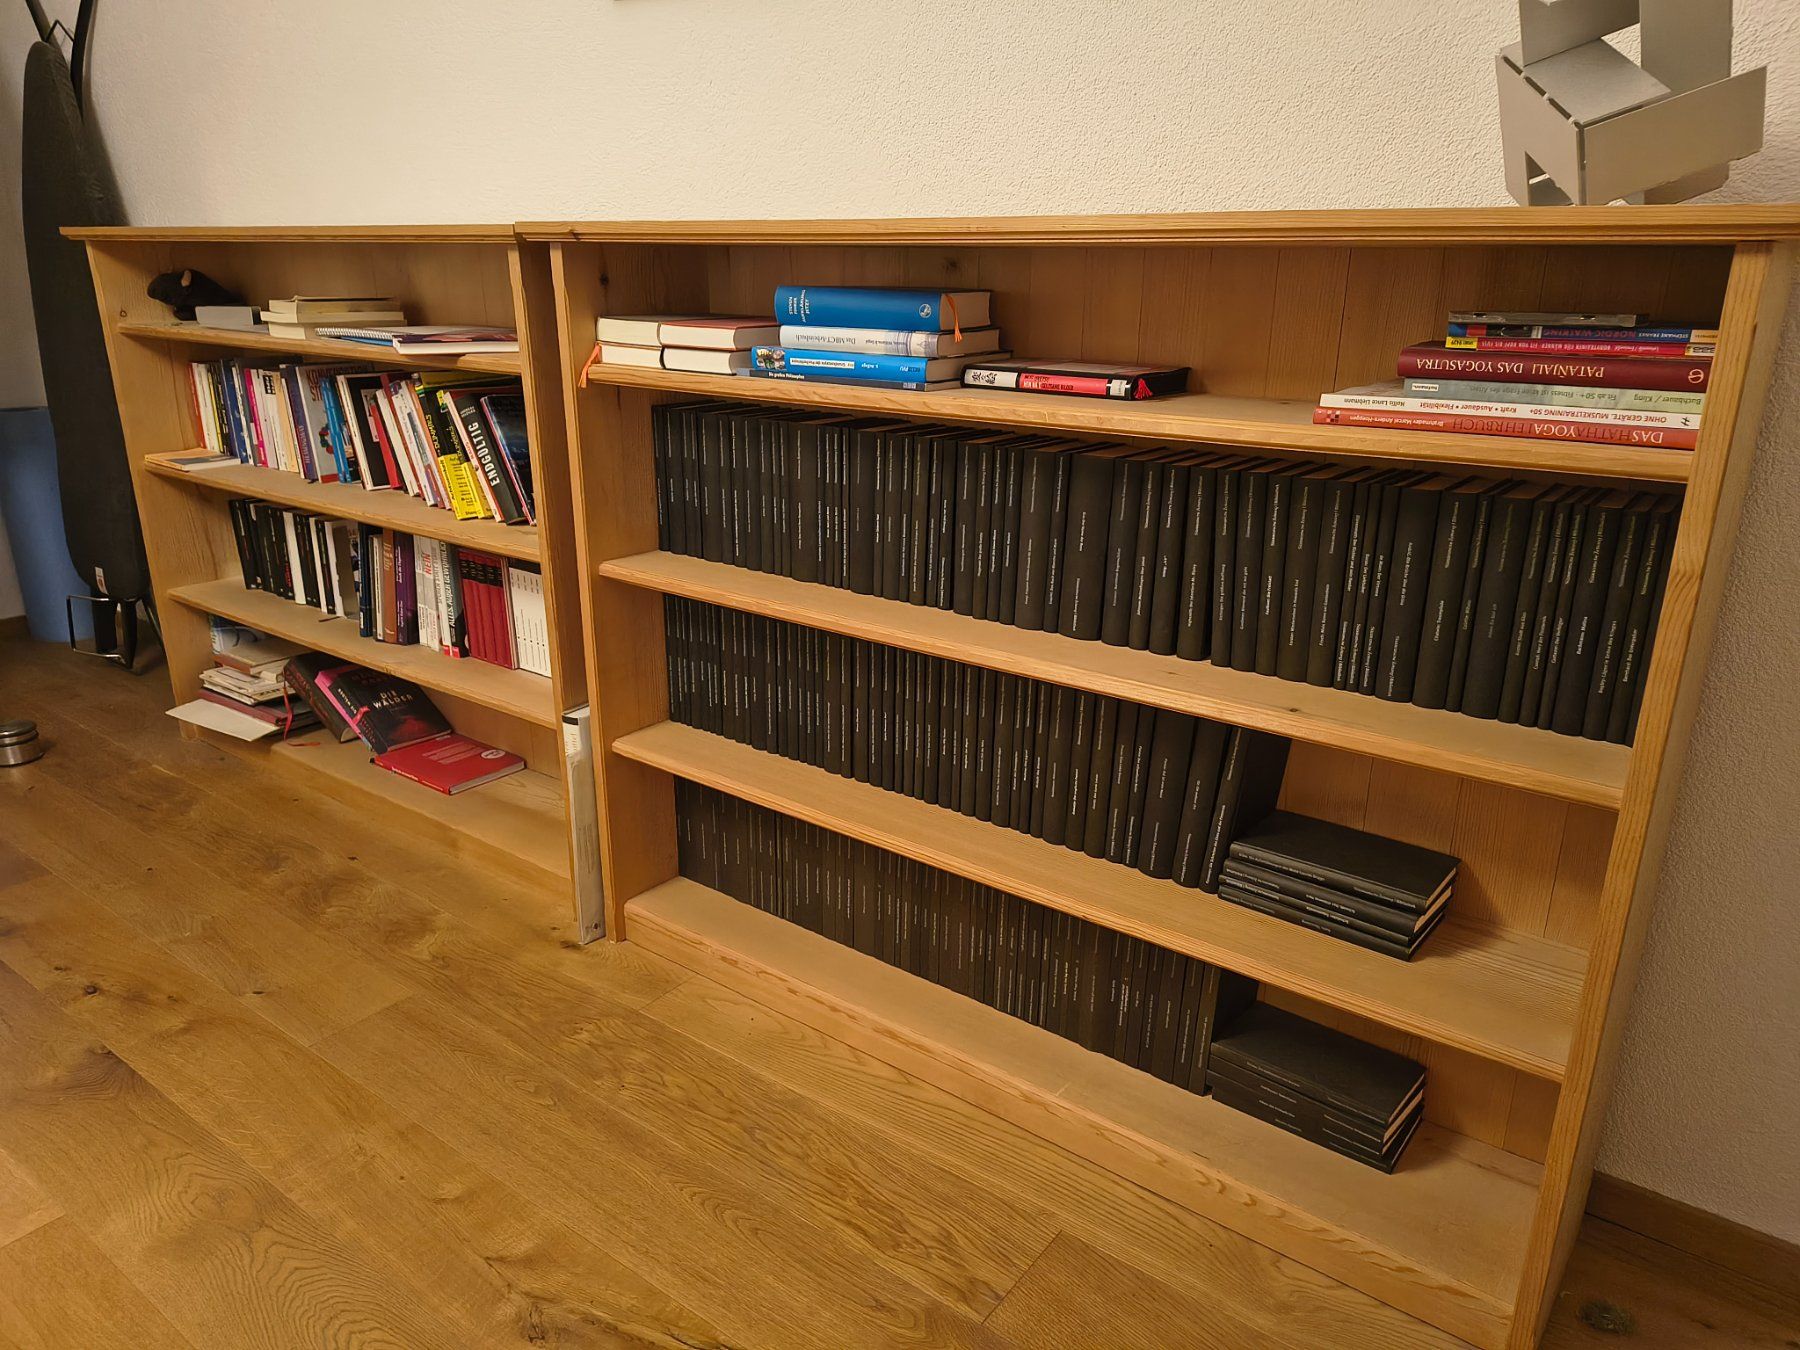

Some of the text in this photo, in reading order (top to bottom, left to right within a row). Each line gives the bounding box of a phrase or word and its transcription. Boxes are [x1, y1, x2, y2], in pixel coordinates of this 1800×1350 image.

[1416, 359, 1523, 373] DAS YOGASUTRA
[1532, 364, 1605, 378] PATAÑJALI
[1420, 402, 1454, 410] Flexibilität
[1461, 404, 1493, 412] Ausdauer
[1544, 409, 1609, 420] MUSKELTRAINING
[468, 422, 500, 486] ENDGÜLTIG
[422, 552, 431, 574] NEIN
[380, 691, 397, 699] DIE
